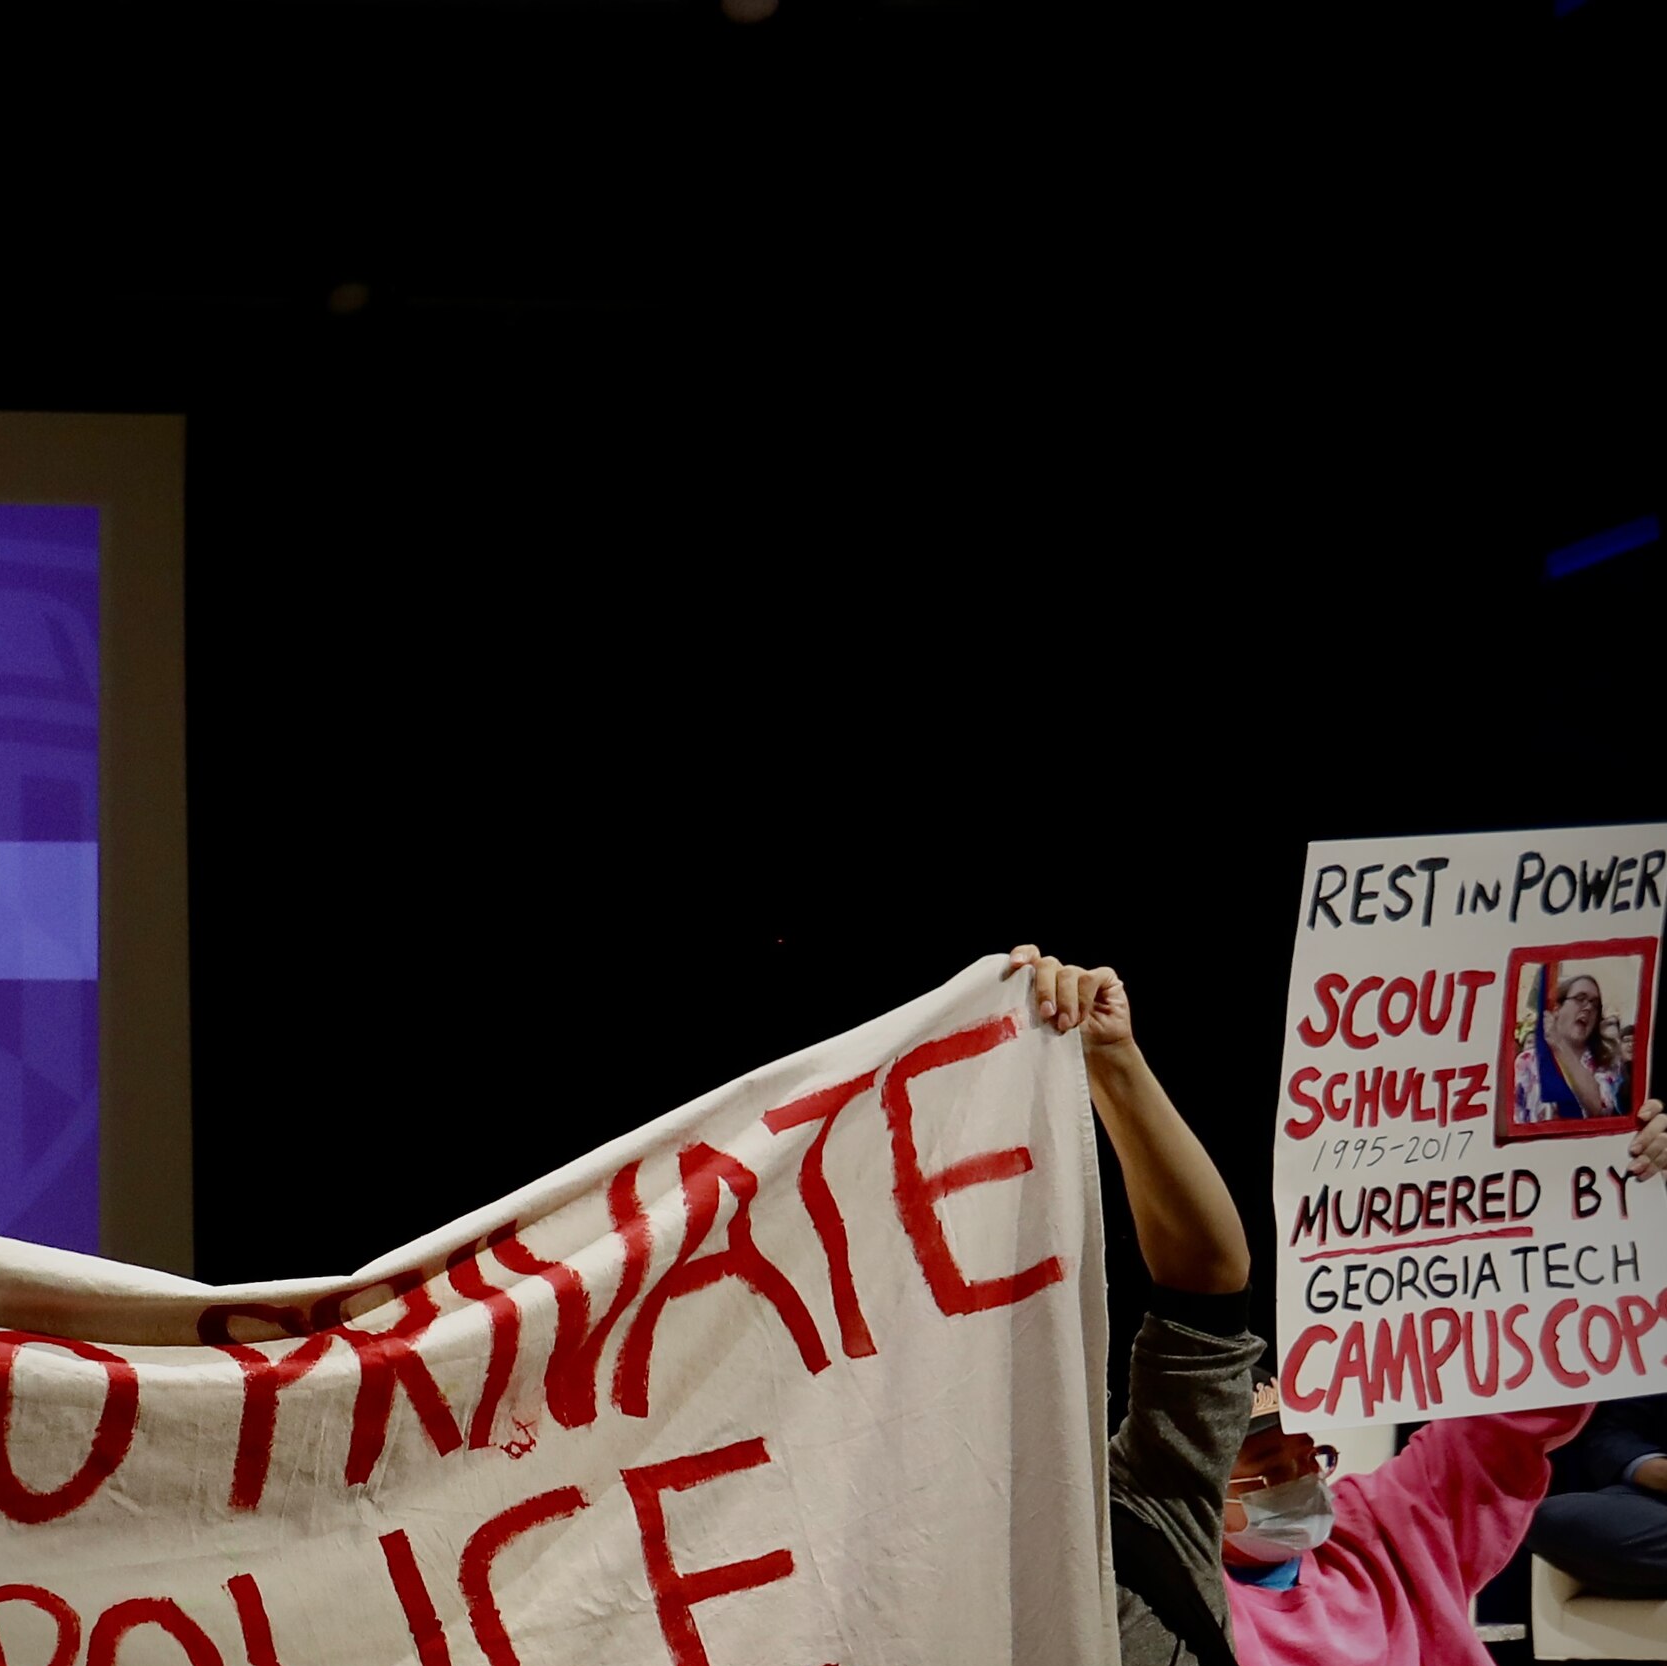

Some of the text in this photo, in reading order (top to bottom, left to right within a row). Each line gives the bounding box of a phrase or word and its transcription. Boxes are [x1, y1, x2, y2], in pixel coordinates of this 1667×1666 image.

[1308, 850, 1666, 929] REST IN POWER
[1297, 969, 1496, 1050] SCOUT
[1284, 1062, 1491, 1141] SCHULTZ
[1312, 1130, 1474, 1173] 1995-2017
[1290, 1165, 1636, 1247] MURDERED BY
[197, 1015, 1065, 1512] PRIVATE
[1306, 1240, 1640, 1314] GEORGIA TECH
[1278, 1304, 1534, 1417] CAMPUS
